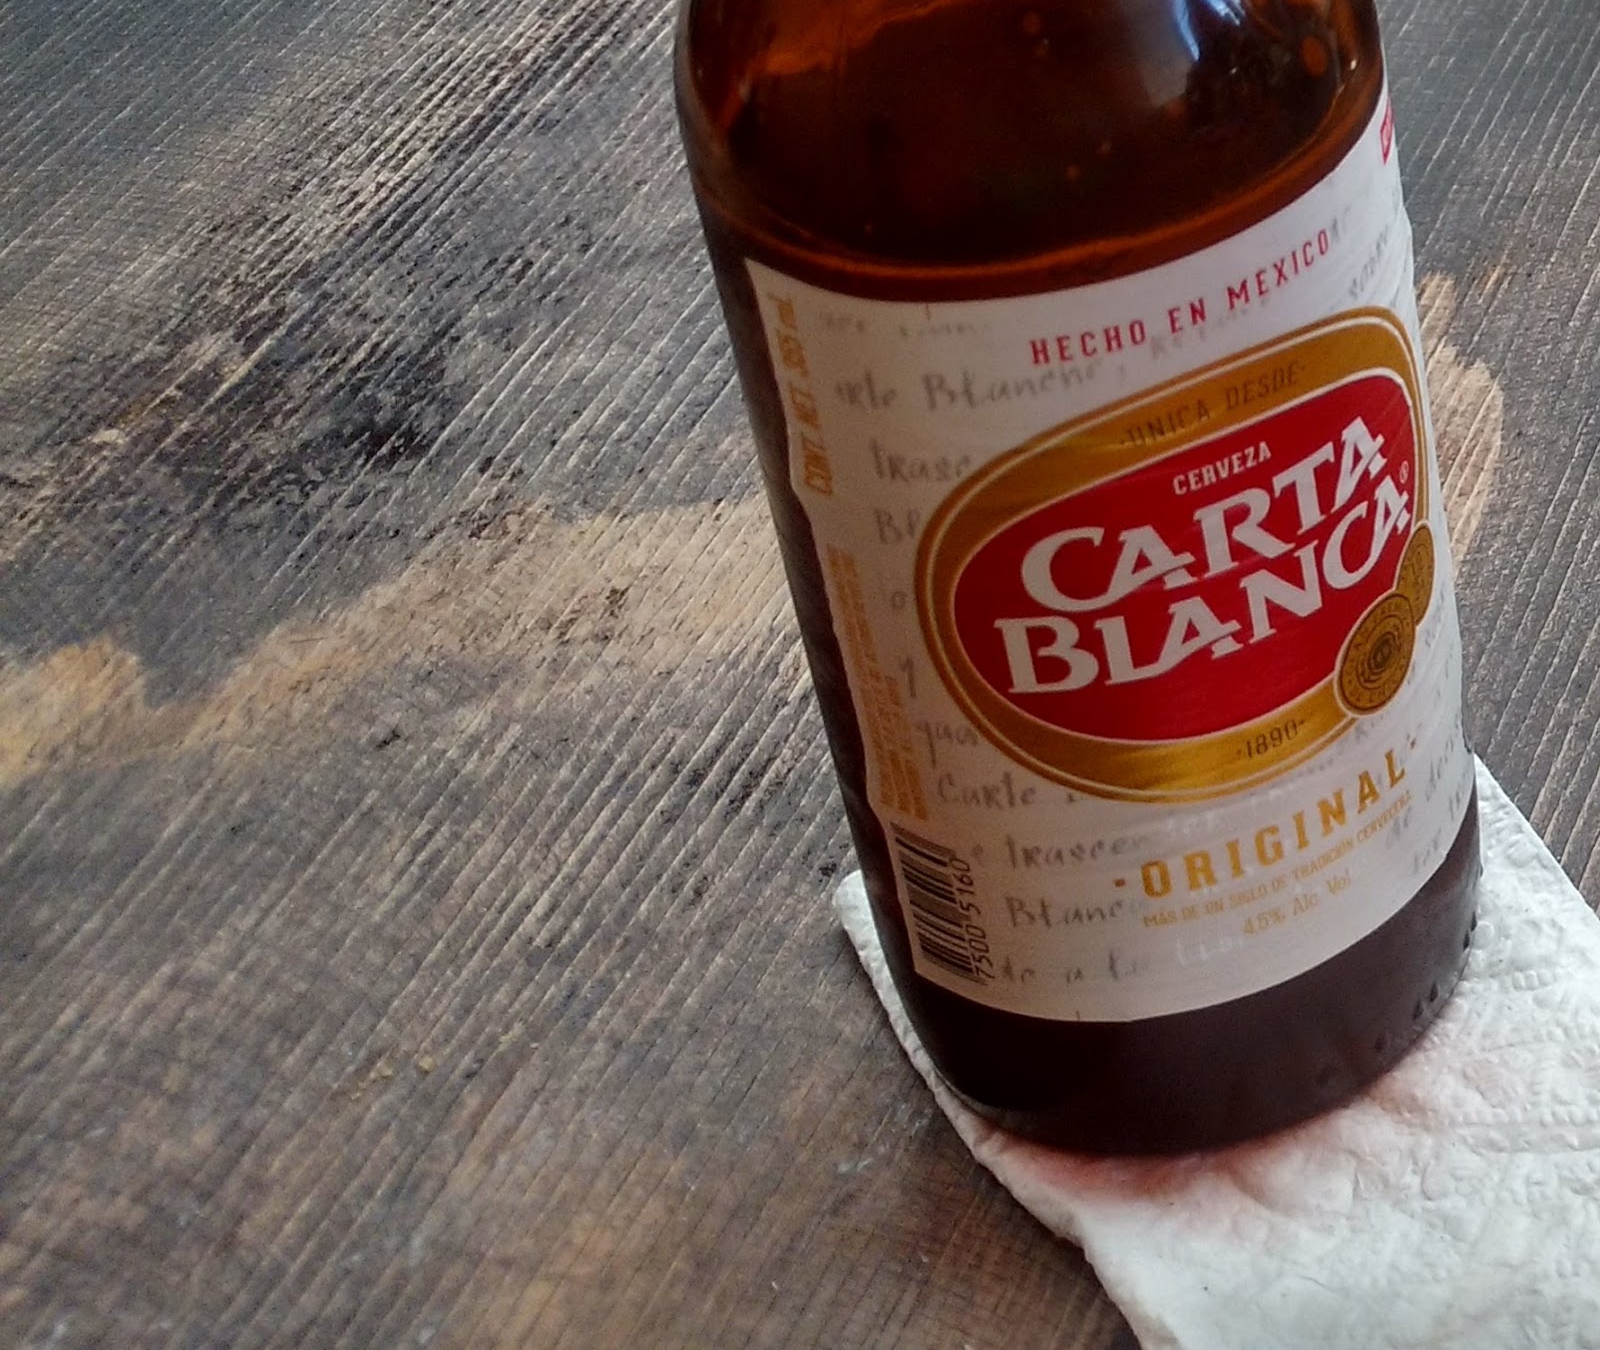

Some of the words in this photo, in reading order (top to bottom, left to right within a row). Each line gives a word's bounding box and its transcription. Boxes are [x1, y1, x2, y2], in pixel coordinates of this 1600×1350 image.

[1030, 319, 1147, 365] HECHO
[1168, 298, 1207, 333] EN
[1226, 228, 1330, 310] MEXICO
[1224, 361, 1300, 411] DESDE
[1172, 441, 1272, 496] CERVEZA
[1020, 416, 1387, 613] CARTA
[993, 475, 1411, 694] BLANCA
[1244, 722, 1298, 760] 1890
[1141, 749, 1406, 899] ORIGINAL
[949, 856, 982, 916] 5160
[1204, 897, 1224, 916] UN
[965, 924, 996, 980] 7500
